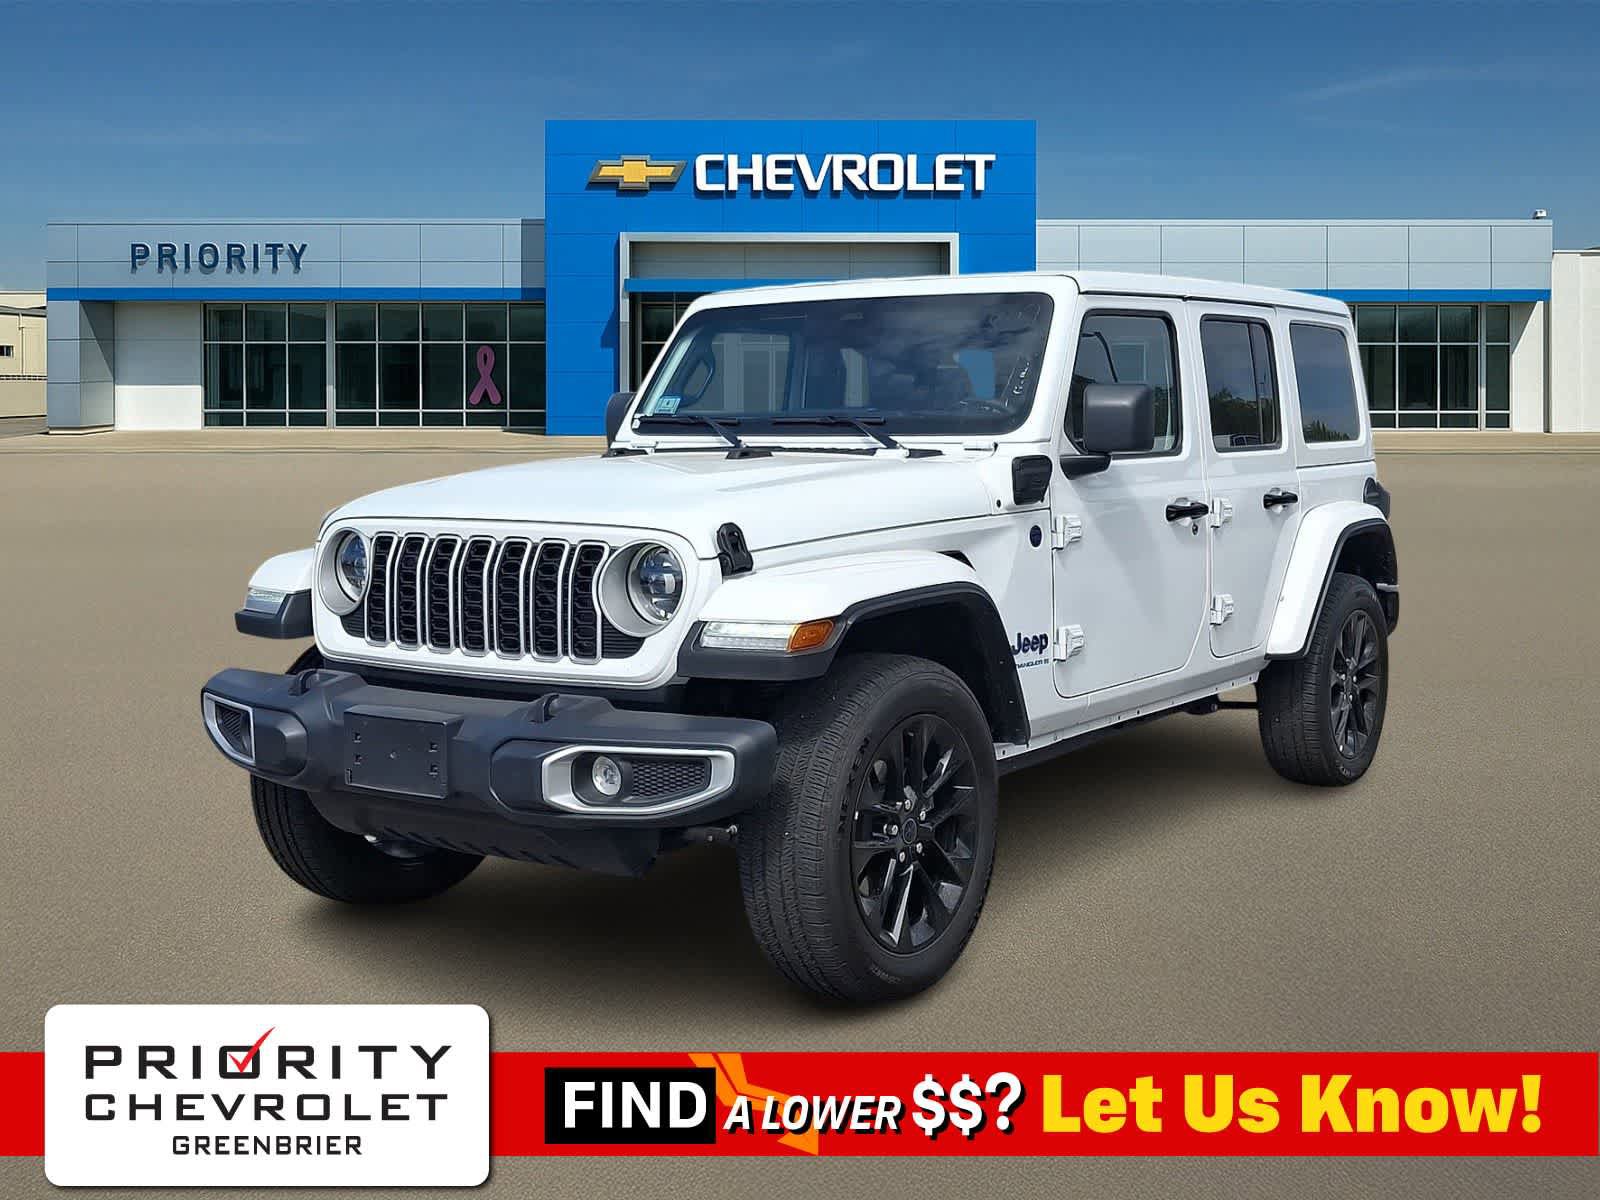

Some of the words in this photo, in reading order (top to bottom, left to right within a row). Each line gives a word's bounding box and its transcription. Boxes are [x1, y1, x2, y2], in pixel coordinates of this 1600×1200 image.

[695, 153, 996, 191] CHEVROLET
[130, 242, 308, 272] PRIORITY
[1011, 632, 1049, 655] Jeep
